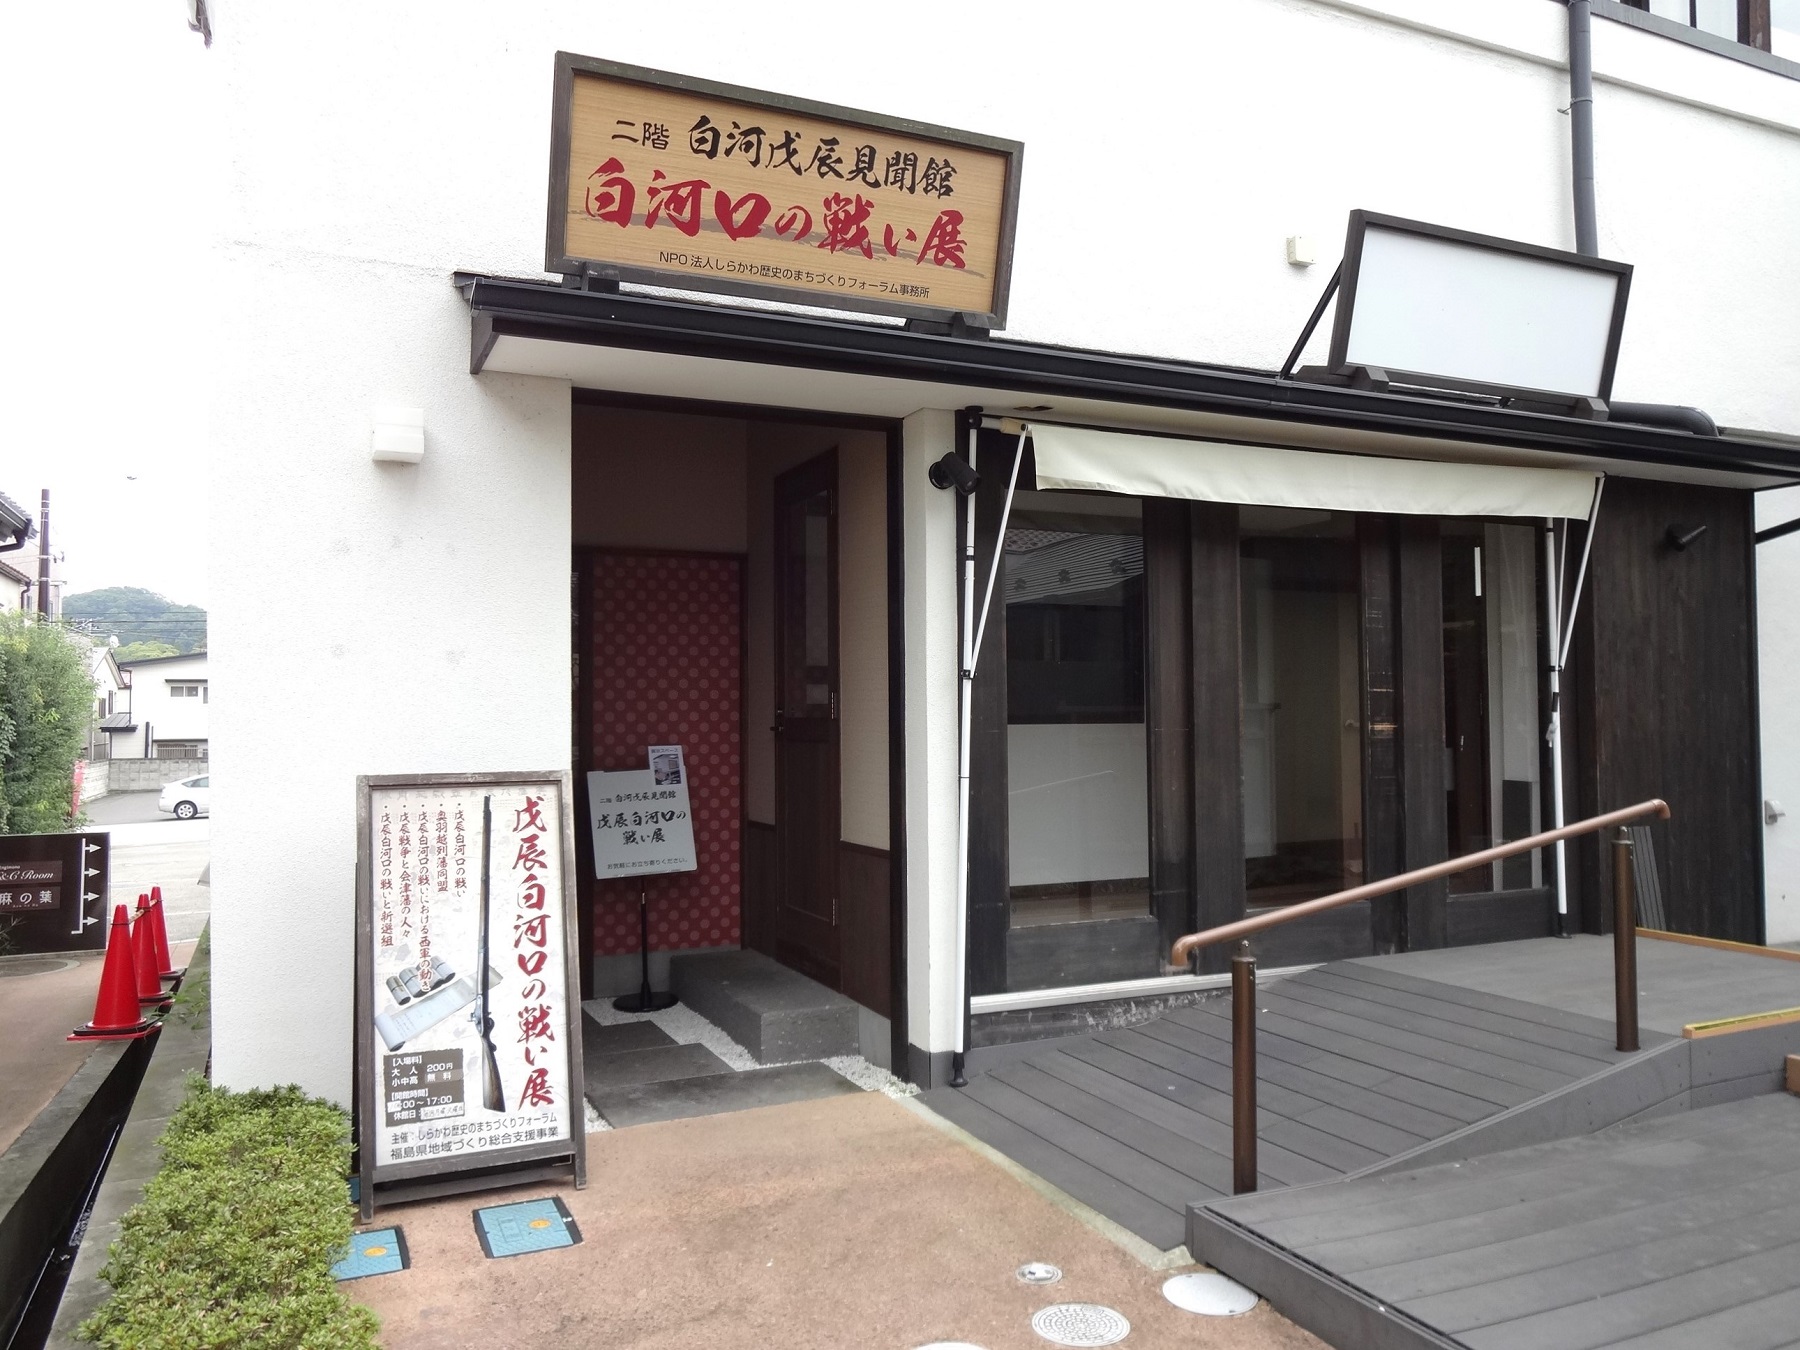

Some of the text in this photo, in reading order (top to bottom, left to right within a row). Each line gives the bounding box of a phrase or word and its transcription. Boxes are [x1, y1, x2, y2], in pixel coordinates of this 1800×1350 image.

[611, 115, 958, 200] 二階 白河戊辰見聞館
[584, 156, 968, 271] 白河口の戦い展
[597, 810, 687, 829] 戊辰白河口の
[622, 828, 666, 845] 戦い展
[20, 869, 54, 880] Room
[512, 795, 556, 1111] 戊辰白河口の戦い展
[426, 1062, 453, 1073] 200円
[391, 1076, 419, 1087] 小中高
[390, 1126, 559, 1161] 福島県地域づくり総合支援事業
